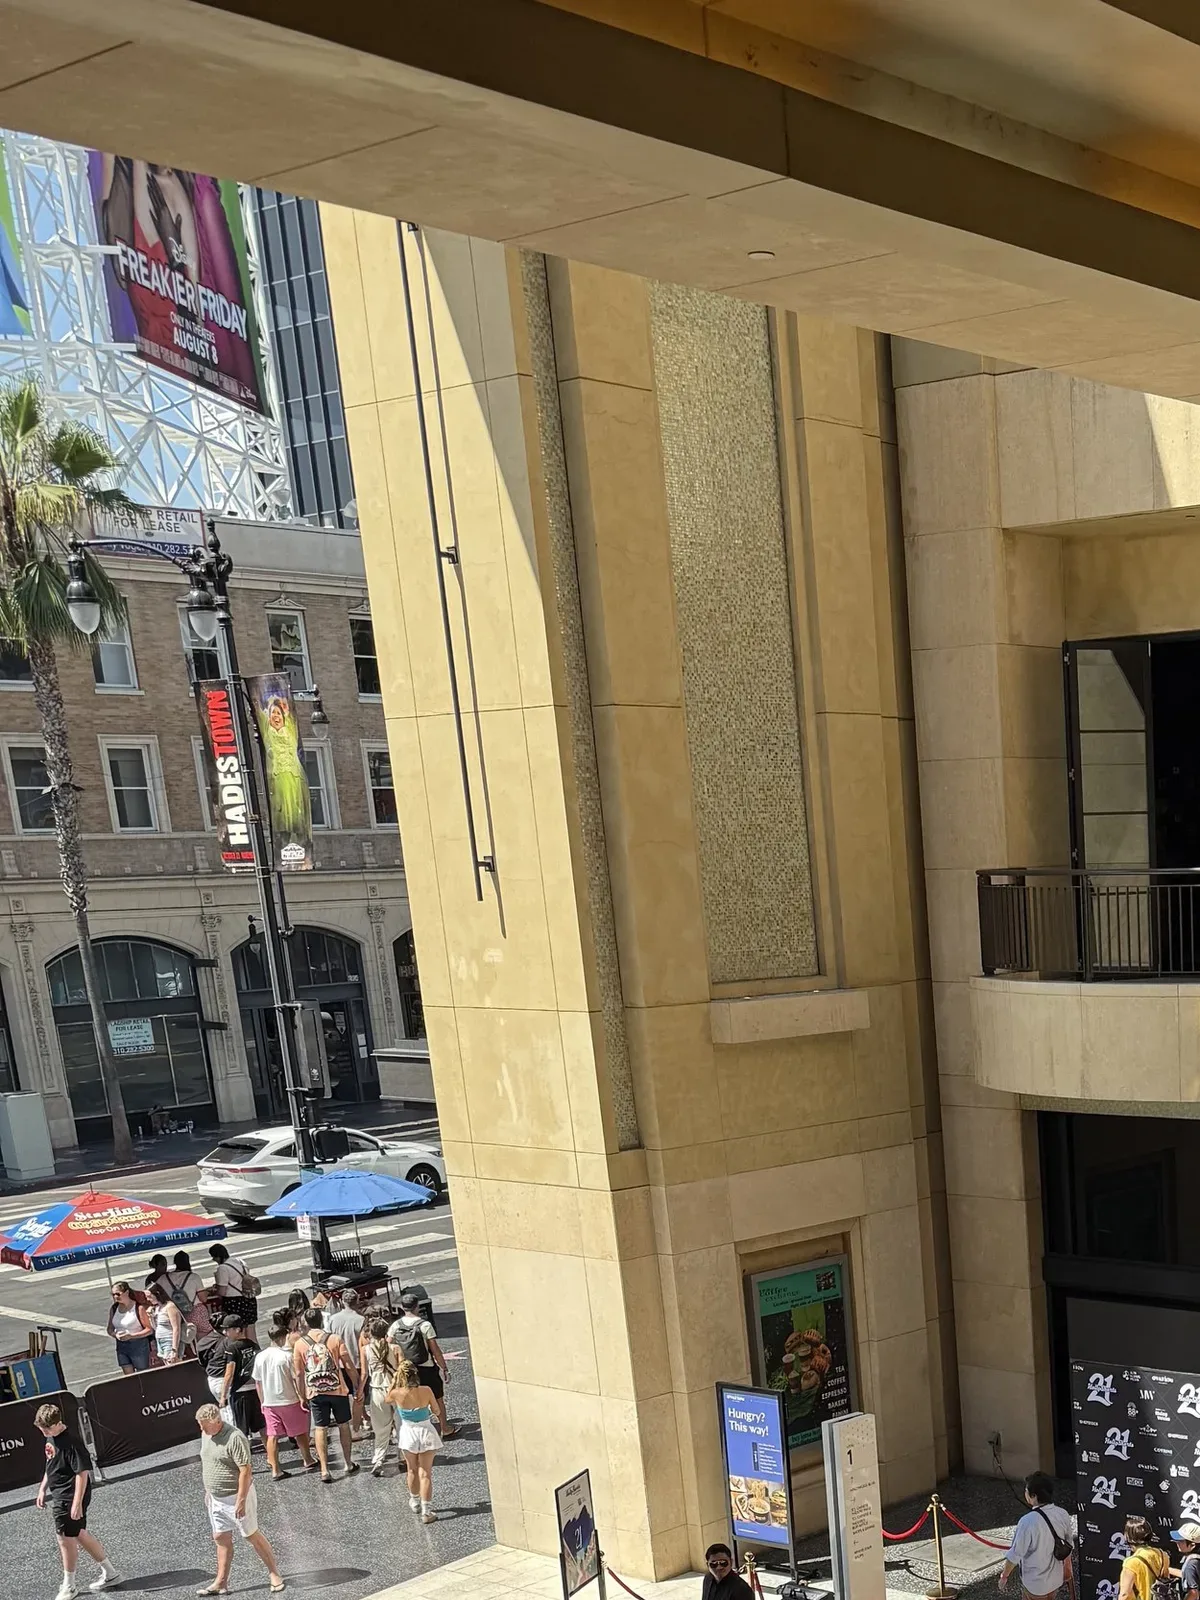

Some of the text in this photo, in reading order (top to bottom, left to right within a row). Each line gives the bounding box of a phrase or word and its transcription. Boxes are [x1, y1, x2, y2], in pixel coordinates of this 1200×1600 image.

[116, 241, 197, 313] FREAKIER
[197, 284, 247, 341] FRIDAY
[173, 328, 211, 360] AUGUST
[212, 348, 218, 364] 8
[157, 510, 198, 523] RETAIL
[114, 517, 180, 532] FOR LEASE
[207, 690, 250, 845] HADESTOWN
[835, 1365, 845, 1373] TEA
[827, 1376, 846, 1387] COFFEE
[822, 1387, 847, 1400] ESPRESSO
[828, 1399, 847, 1409] BAKERY
[728, 1408, 766, 1423] Hungry?
[729, 1420, 769, 1437] This way!
[847, 1449, 853, 1465] 1
